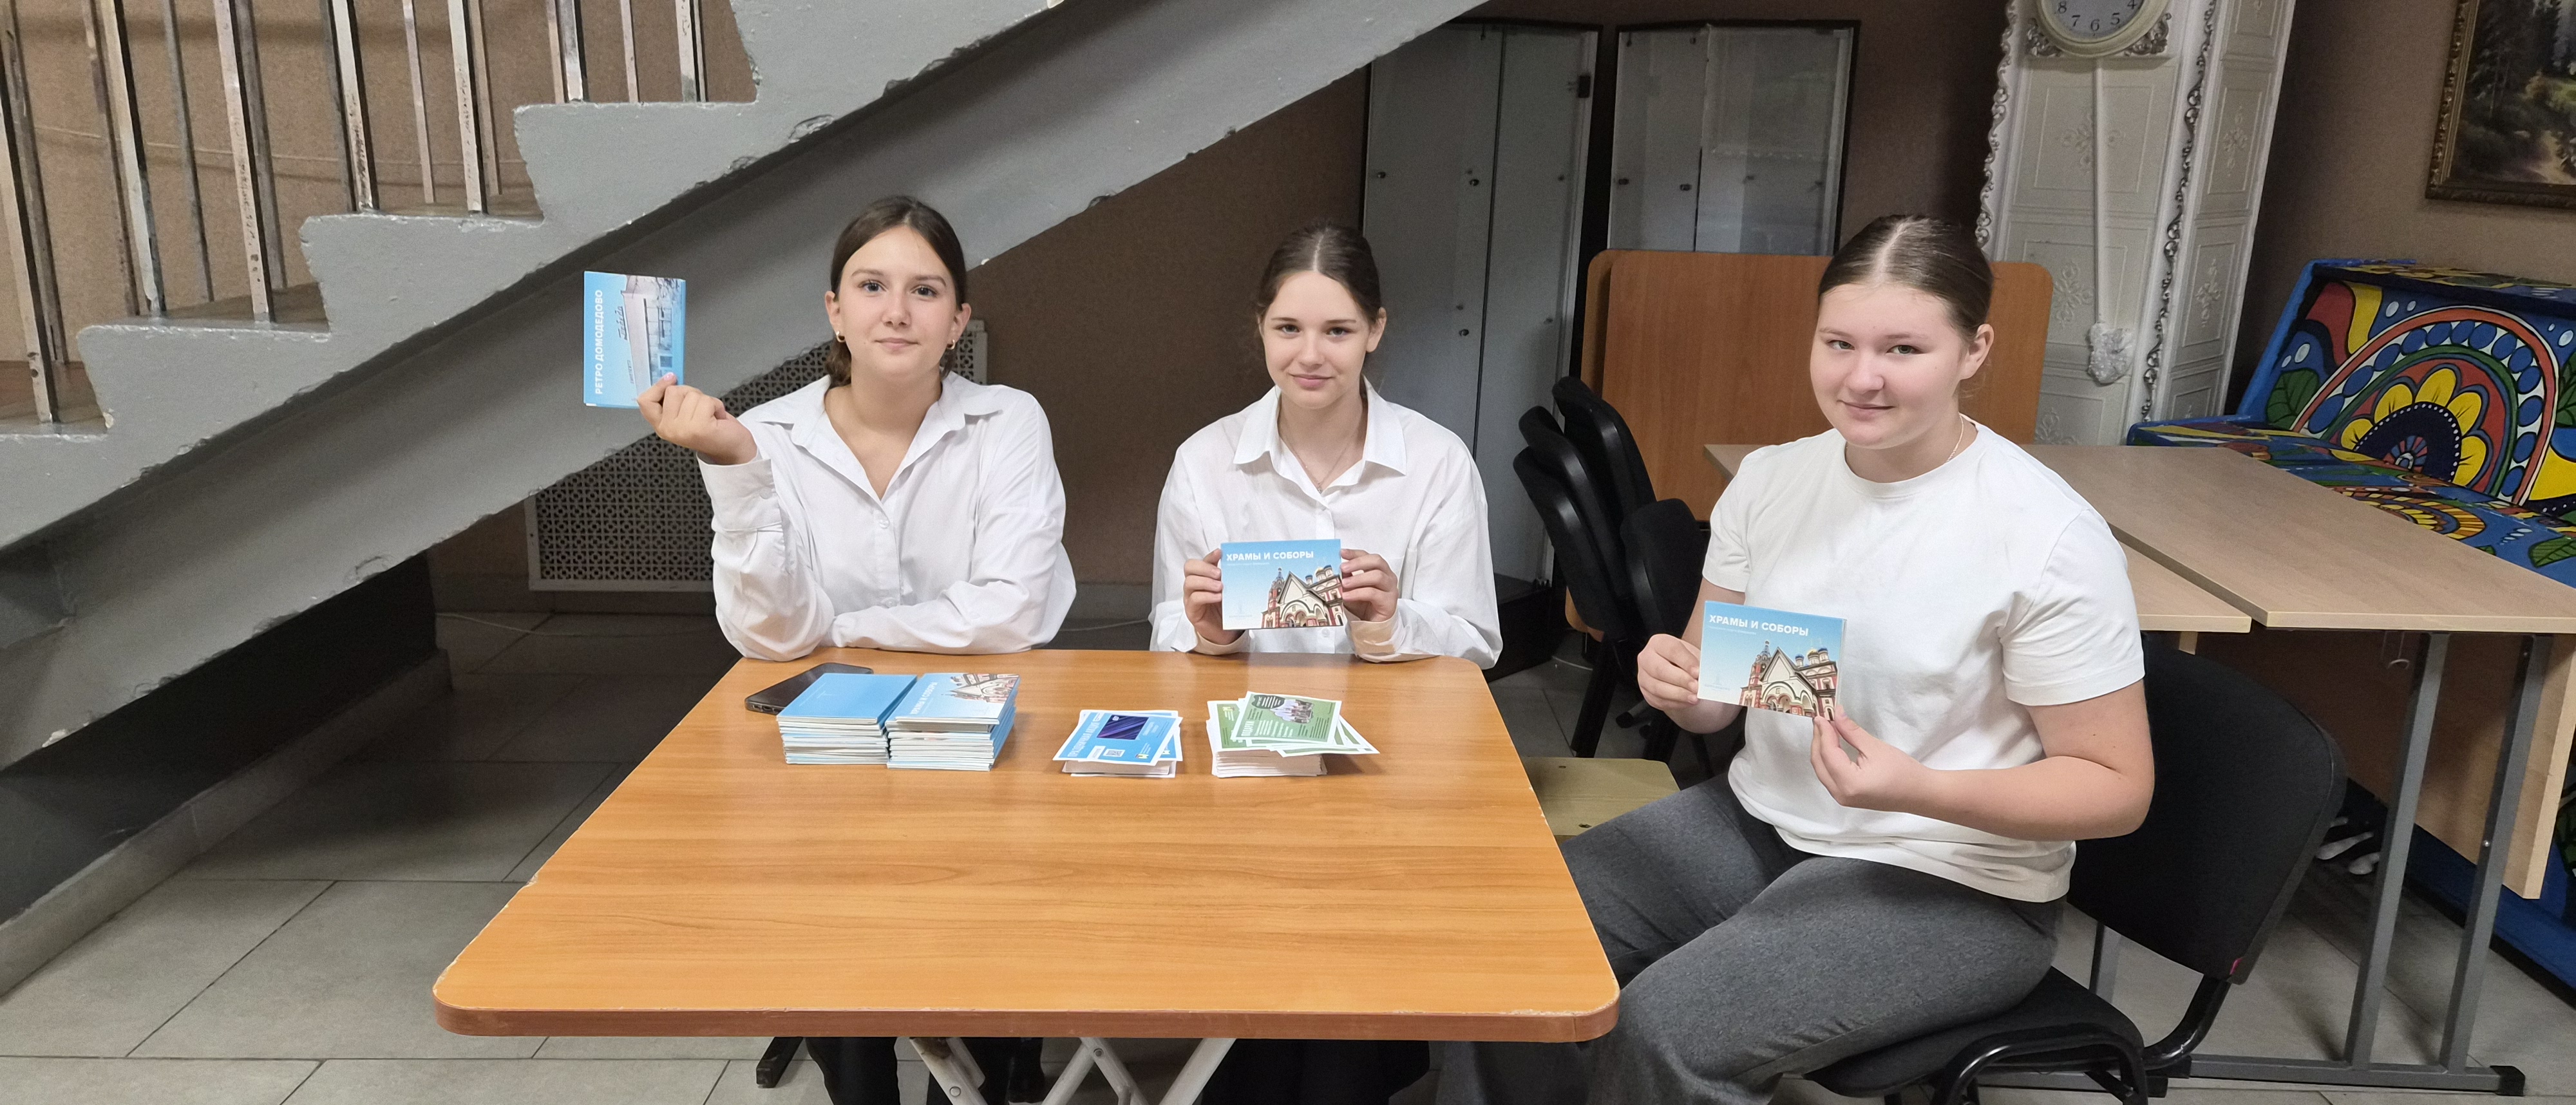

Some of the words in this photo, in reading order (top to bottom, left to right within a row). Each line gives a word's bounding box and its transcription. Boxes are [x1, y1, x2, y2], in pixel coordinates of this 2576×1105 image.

[2058, 0, 2067, 13] 8
[2127, 0, 2137, 9] 4
[2072, 15, 2081, 26] 7
[2110, 12, 2119, 25] 5
[2090, 19, 2100, 31] 6
[595, 290, 604, 362] ДОМОДЕДОВО
[1226, 552, 1261, 561] ХРАМЫ
[1264, 552, 1271, 560] И
[1273, 551, 1314, 560] СОБОРЫ
[1709, 614, 1748, 628] ХРАМЫ
[1751, 621, 1759, 629] И
[1761, 622, 1809, 636] СОБОРЫ
